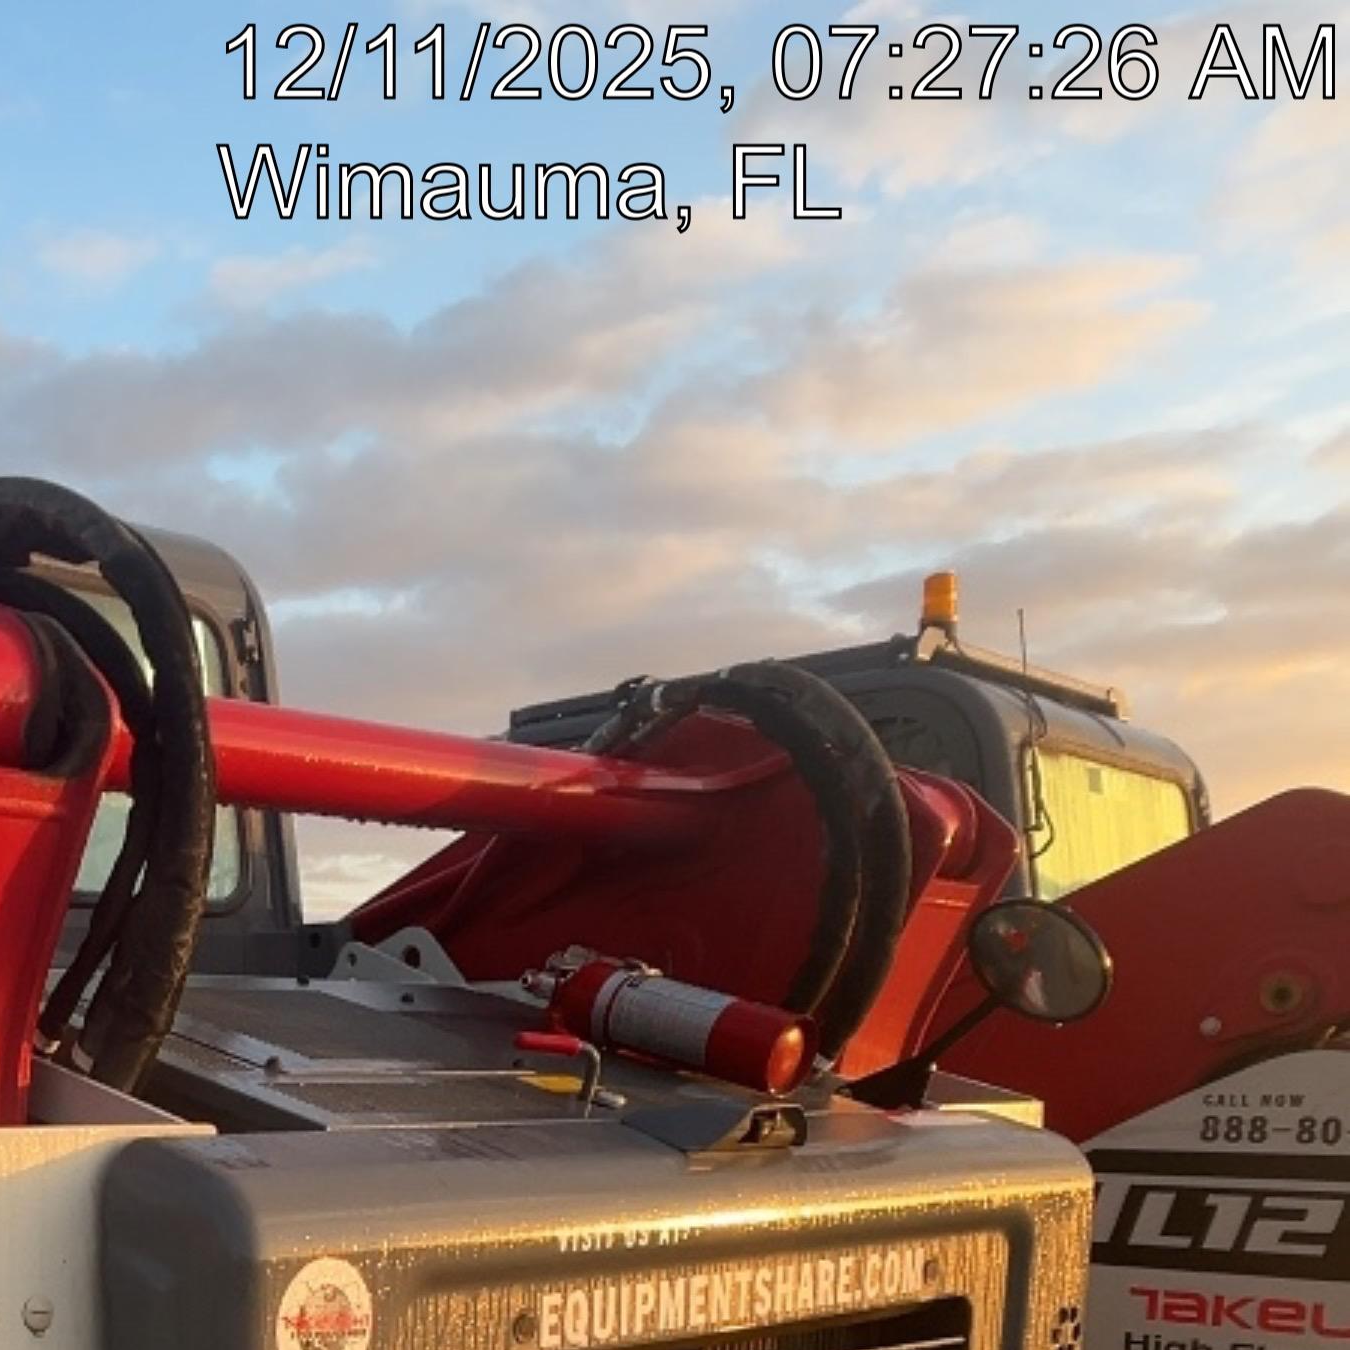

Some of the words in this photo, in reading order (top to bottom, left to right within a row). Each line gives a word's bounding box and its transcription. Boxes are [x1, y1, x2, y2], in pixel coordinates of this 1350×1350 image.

[1202, 1094, 1249, 1107] CALL
[1260, 1094, 1306, 1107] NOW
[1200, 1115, 1350, 1147] 888-80
[538, 1248, 925, 1349] EQUIPMENTSHARE.COM
